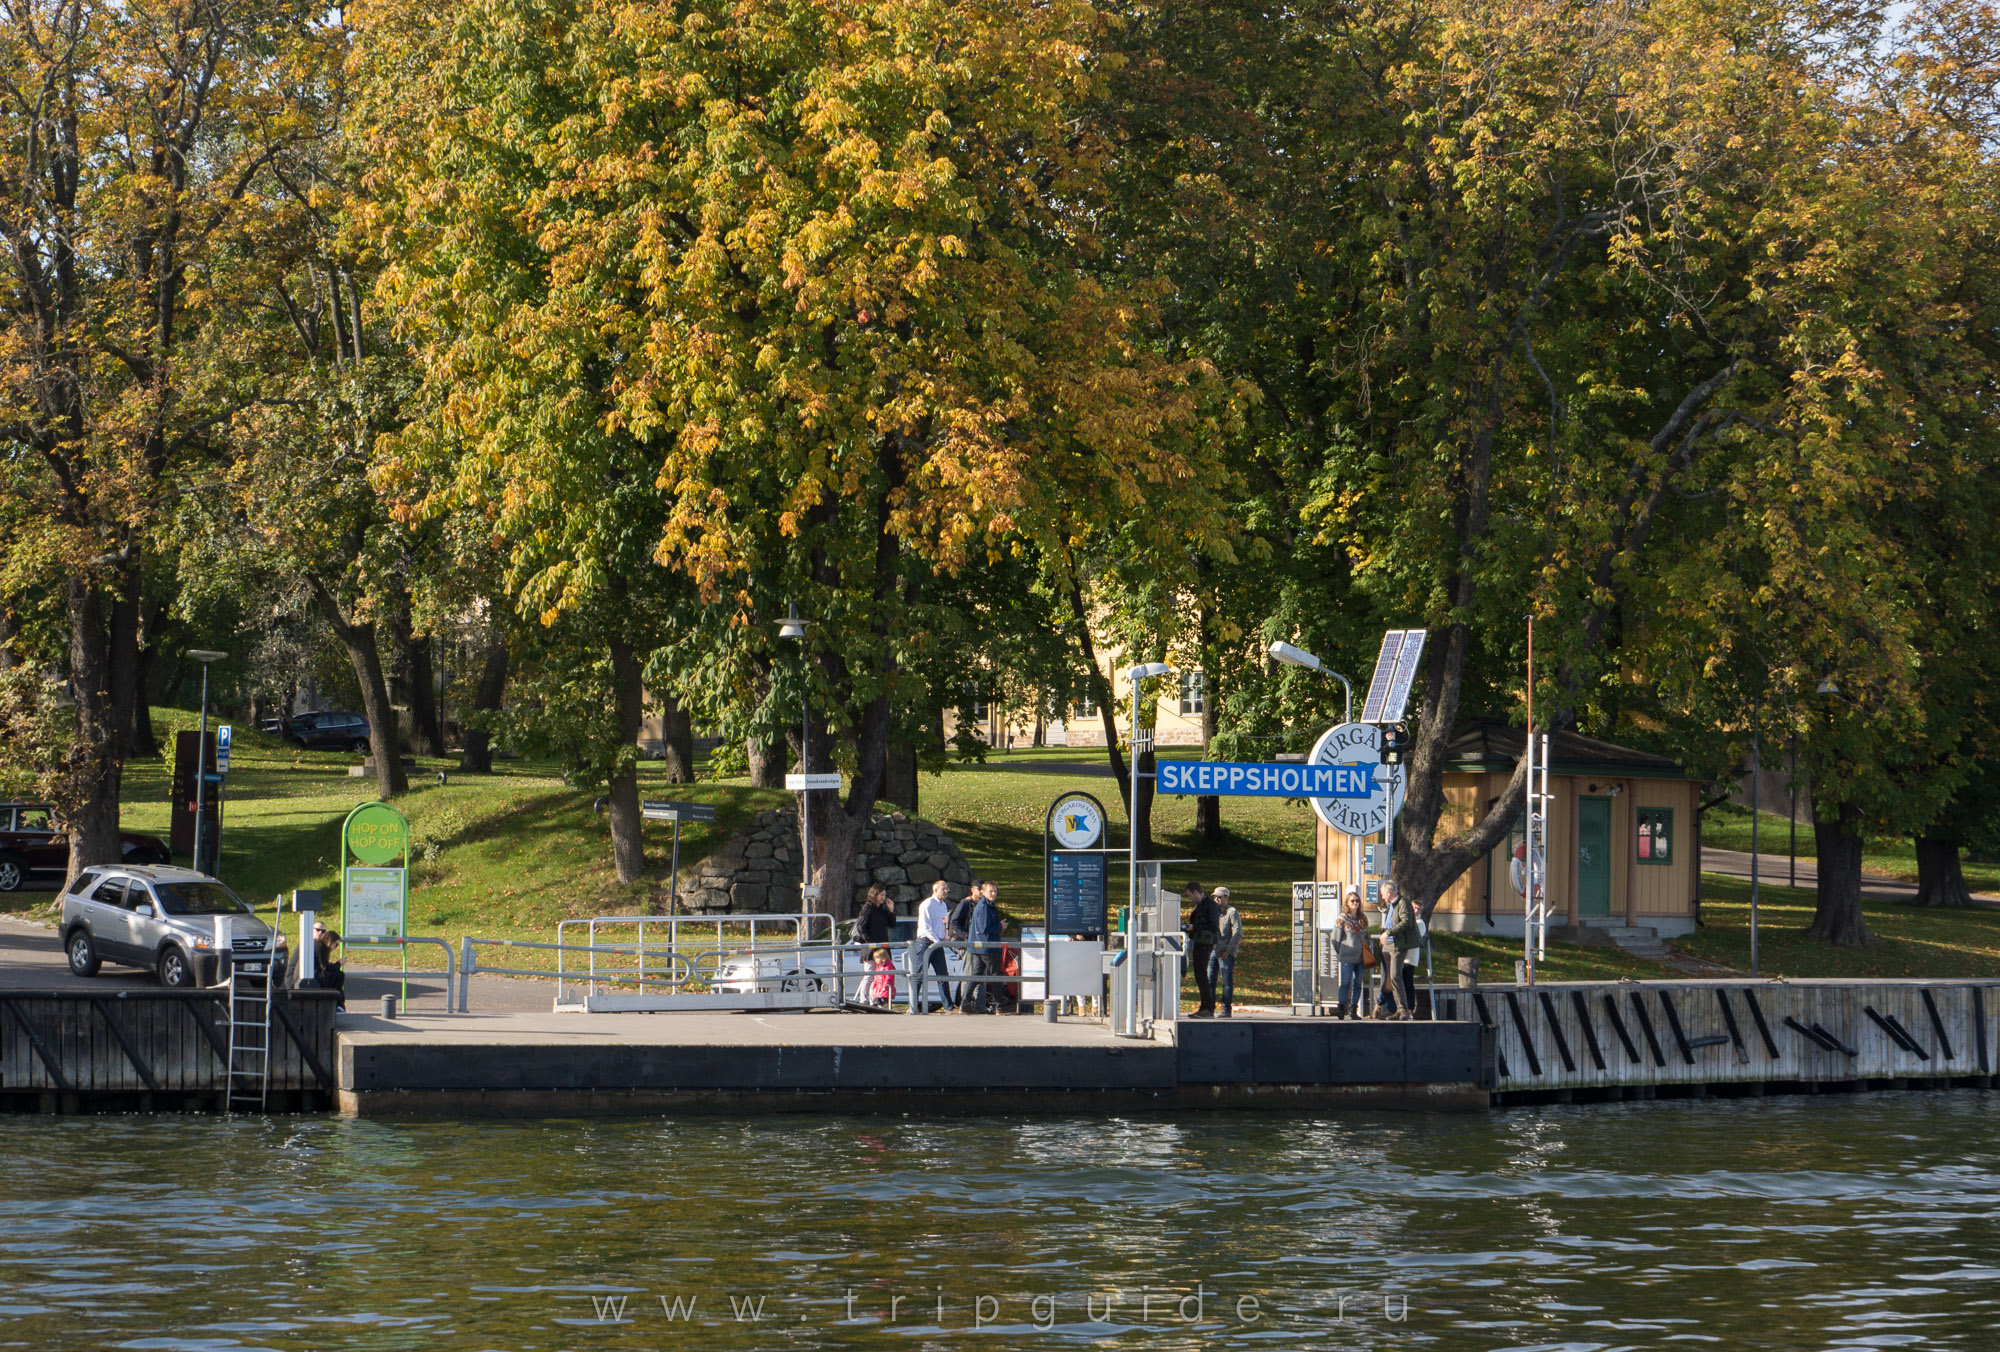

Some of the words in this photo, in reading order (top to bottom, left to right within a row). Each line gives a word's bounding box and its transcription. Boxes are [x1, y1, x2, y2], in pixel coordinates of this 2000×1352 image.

[221, 728, 228, 745] P
[1163, 765, 1366, 793] SKEPPSHOLMEN
[352, 822, 377, 835] HOP
[380, 823, 399, 835] ON
[350, 836, 376, 848] HOP
[378, 838, 400, 849] OFF
